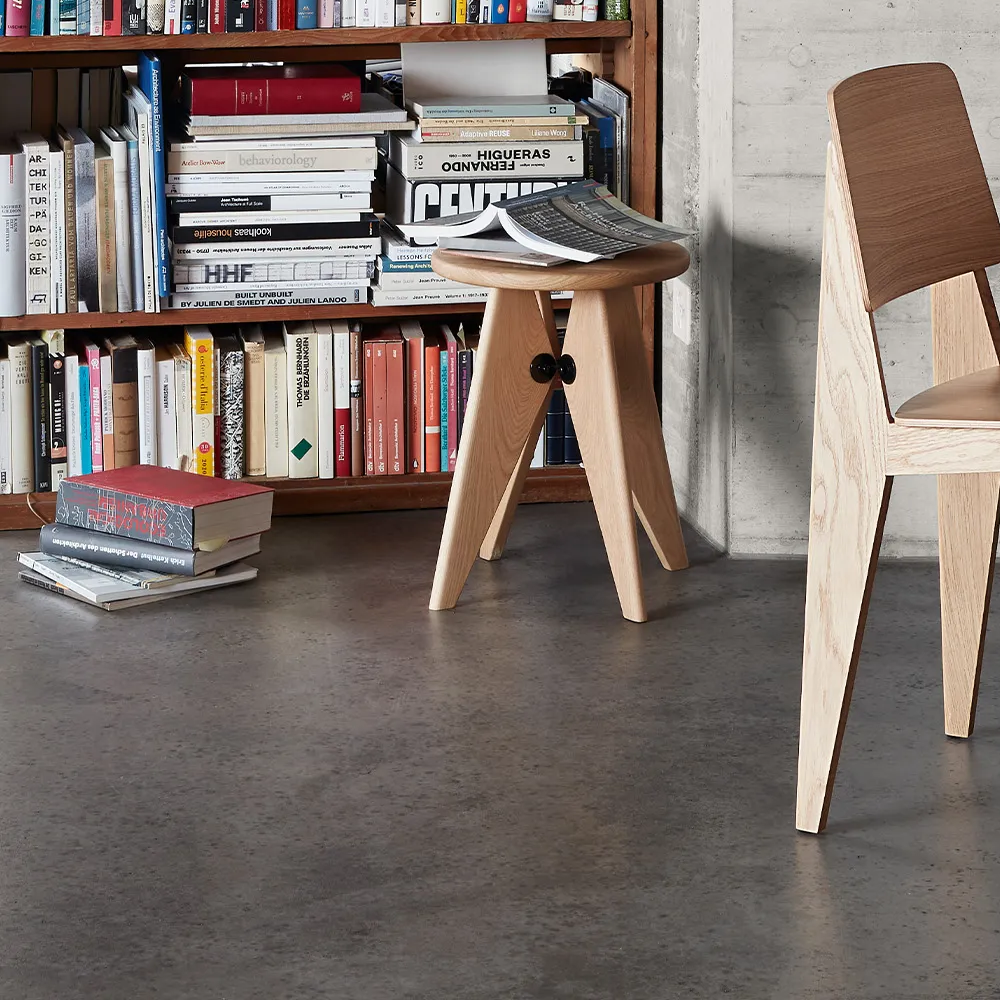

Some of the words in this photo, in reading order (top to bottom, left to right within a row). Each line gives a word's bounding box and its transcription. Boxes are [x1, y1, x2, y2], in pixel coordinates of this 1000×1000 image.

[168, 0, 176, 12] Eva
[478, 149, 550, 160] HIGUERAS
[29, 155, 46, 163] AR-
[240, 154, 317, 167] behaviorology
[442, 161, 515, 172] FERNANDO
[29, 169, 46, 177] CHI
[30, 183, 47, 191] TEK
[30, 197, 47, 205] TUR
[30, 210, 47, 218] -PÄ
[205, 264, 253, 283] HHF
[52, 538, 86, 550] Architekten
[88, 544, 98, 552] des
[100, 546, 126, 557] Schatten
[126, 550, 138, 558] Der
[170, 558, 186, 566] Erich
